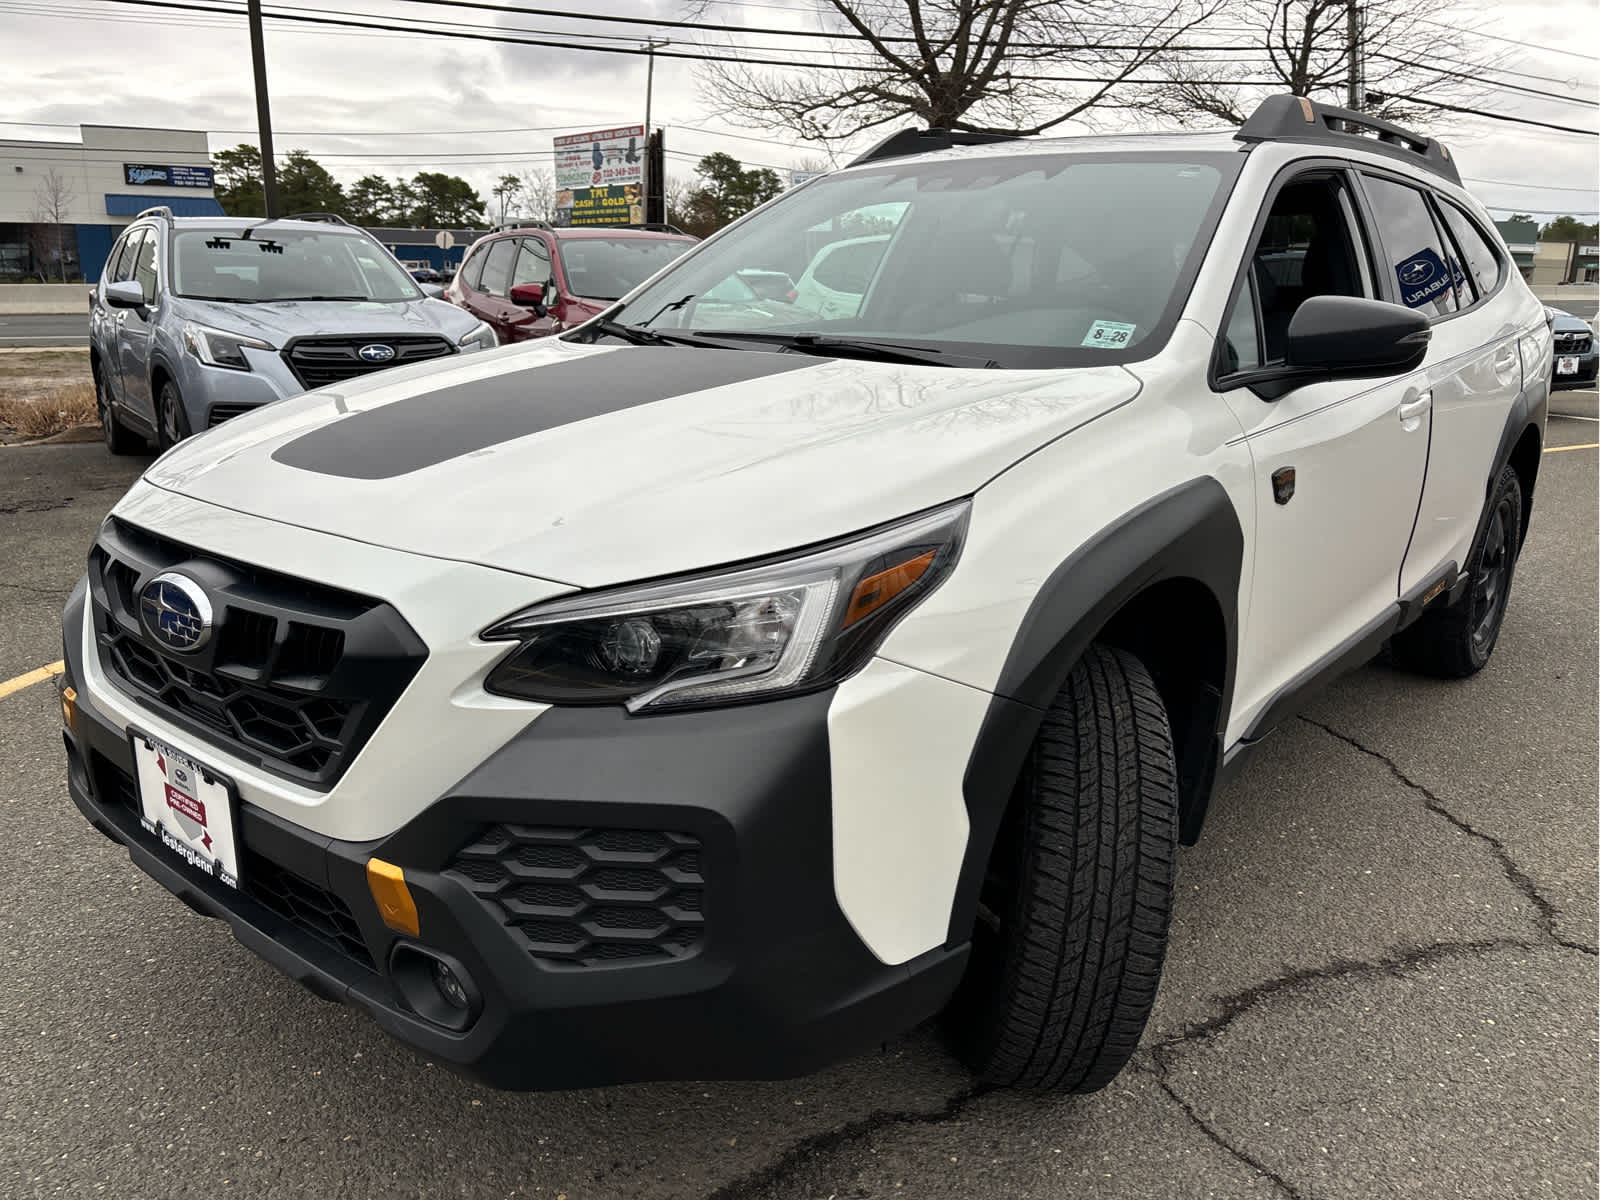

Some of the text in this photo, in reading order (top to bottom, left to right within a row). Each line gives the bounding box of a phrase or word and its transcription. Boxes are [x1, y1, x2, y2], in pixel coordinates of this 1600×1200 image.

[574, 200, 593, 208] CASH
[602, 197, 625, 206] GOLD
[1094, 329, 1128, 343] 8 28
[170, 790, 199, 811] CERTIFIED
[170, 796, 203, 821] PRE-OWNED
[161, 828, 214, 876] lesterglenn
